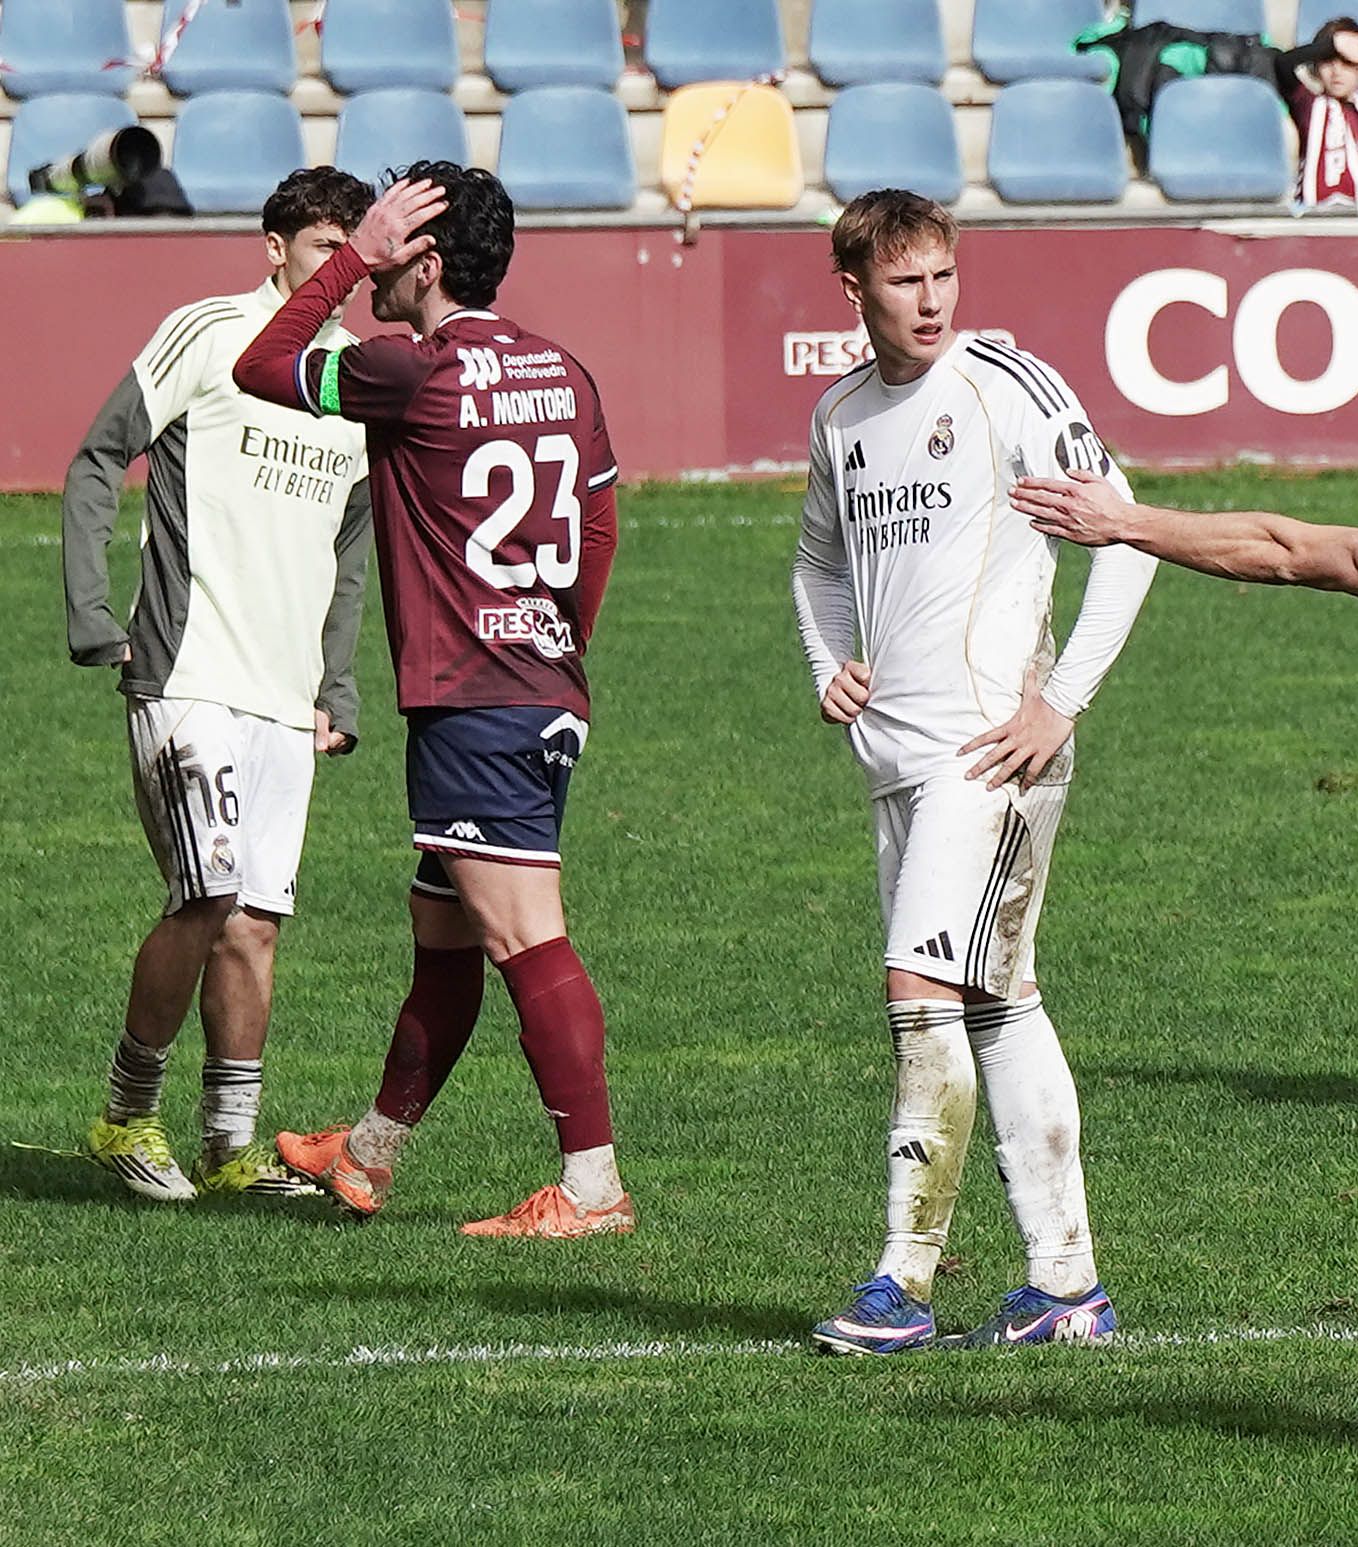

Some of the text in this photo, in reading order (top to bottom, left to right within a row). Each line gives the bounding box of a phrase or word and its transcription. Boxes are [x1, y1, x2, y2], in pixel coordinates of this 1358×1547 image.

[459, 386, 577, 429] A. MONTORO
[1061, 423, 1104, 477] hp
[253, 465, 283, 492] FLY
[461, 433, 582, 589] 23
[846, 480, 952, 522] Emirates
